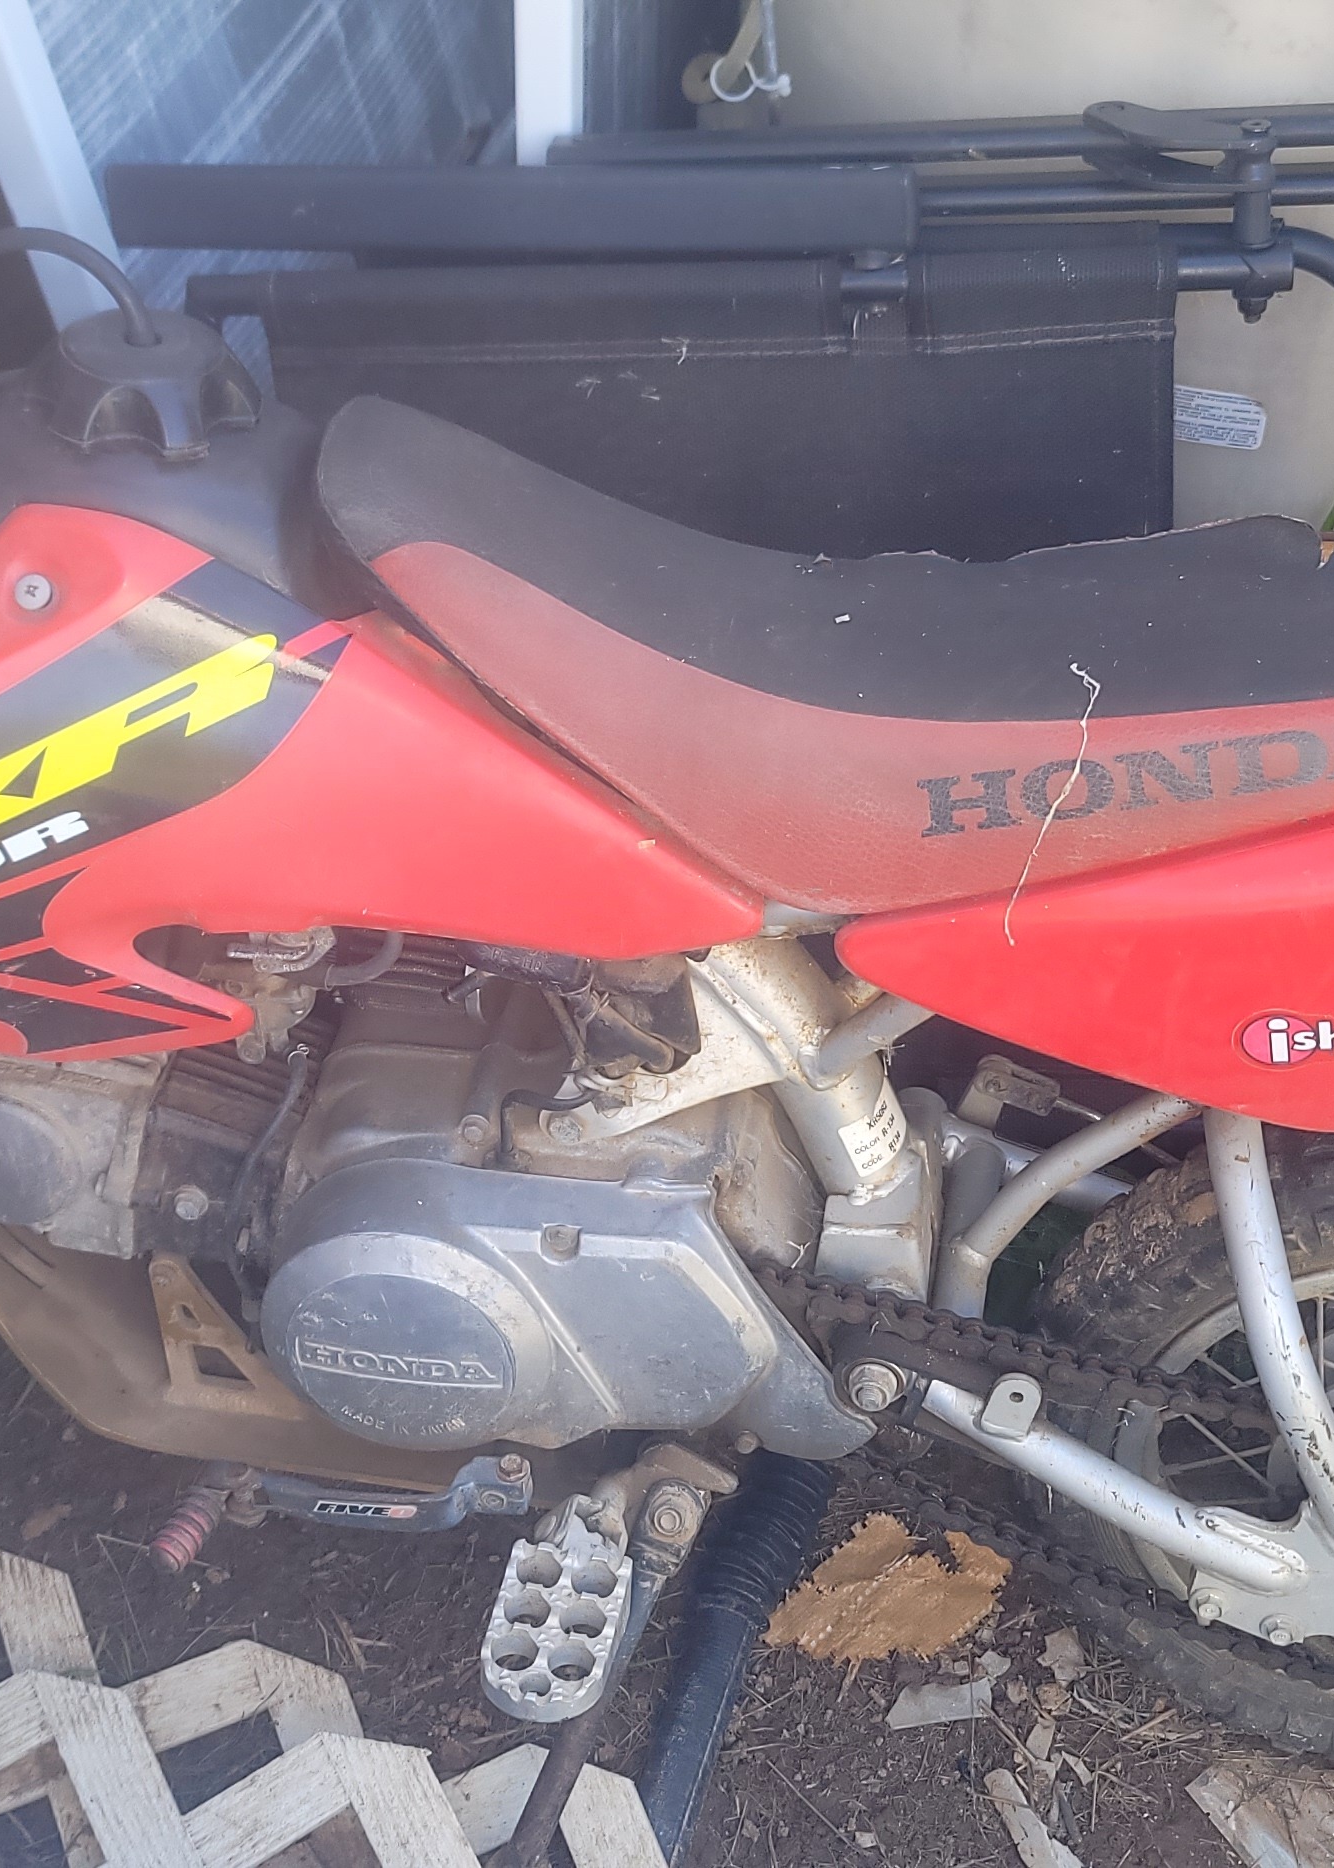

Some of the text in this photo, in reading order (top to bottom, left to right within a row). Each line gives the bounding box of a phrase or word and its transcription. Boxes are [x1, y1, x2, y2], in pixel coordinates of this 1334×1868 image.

[855, 1136, 880, 1154] COLOR
[862, 1154, 883, 1169] CODE
[304, 1340, 498, 1380] HONDA
[340, 1404, 466, 1437] MADE IN JAPAN
